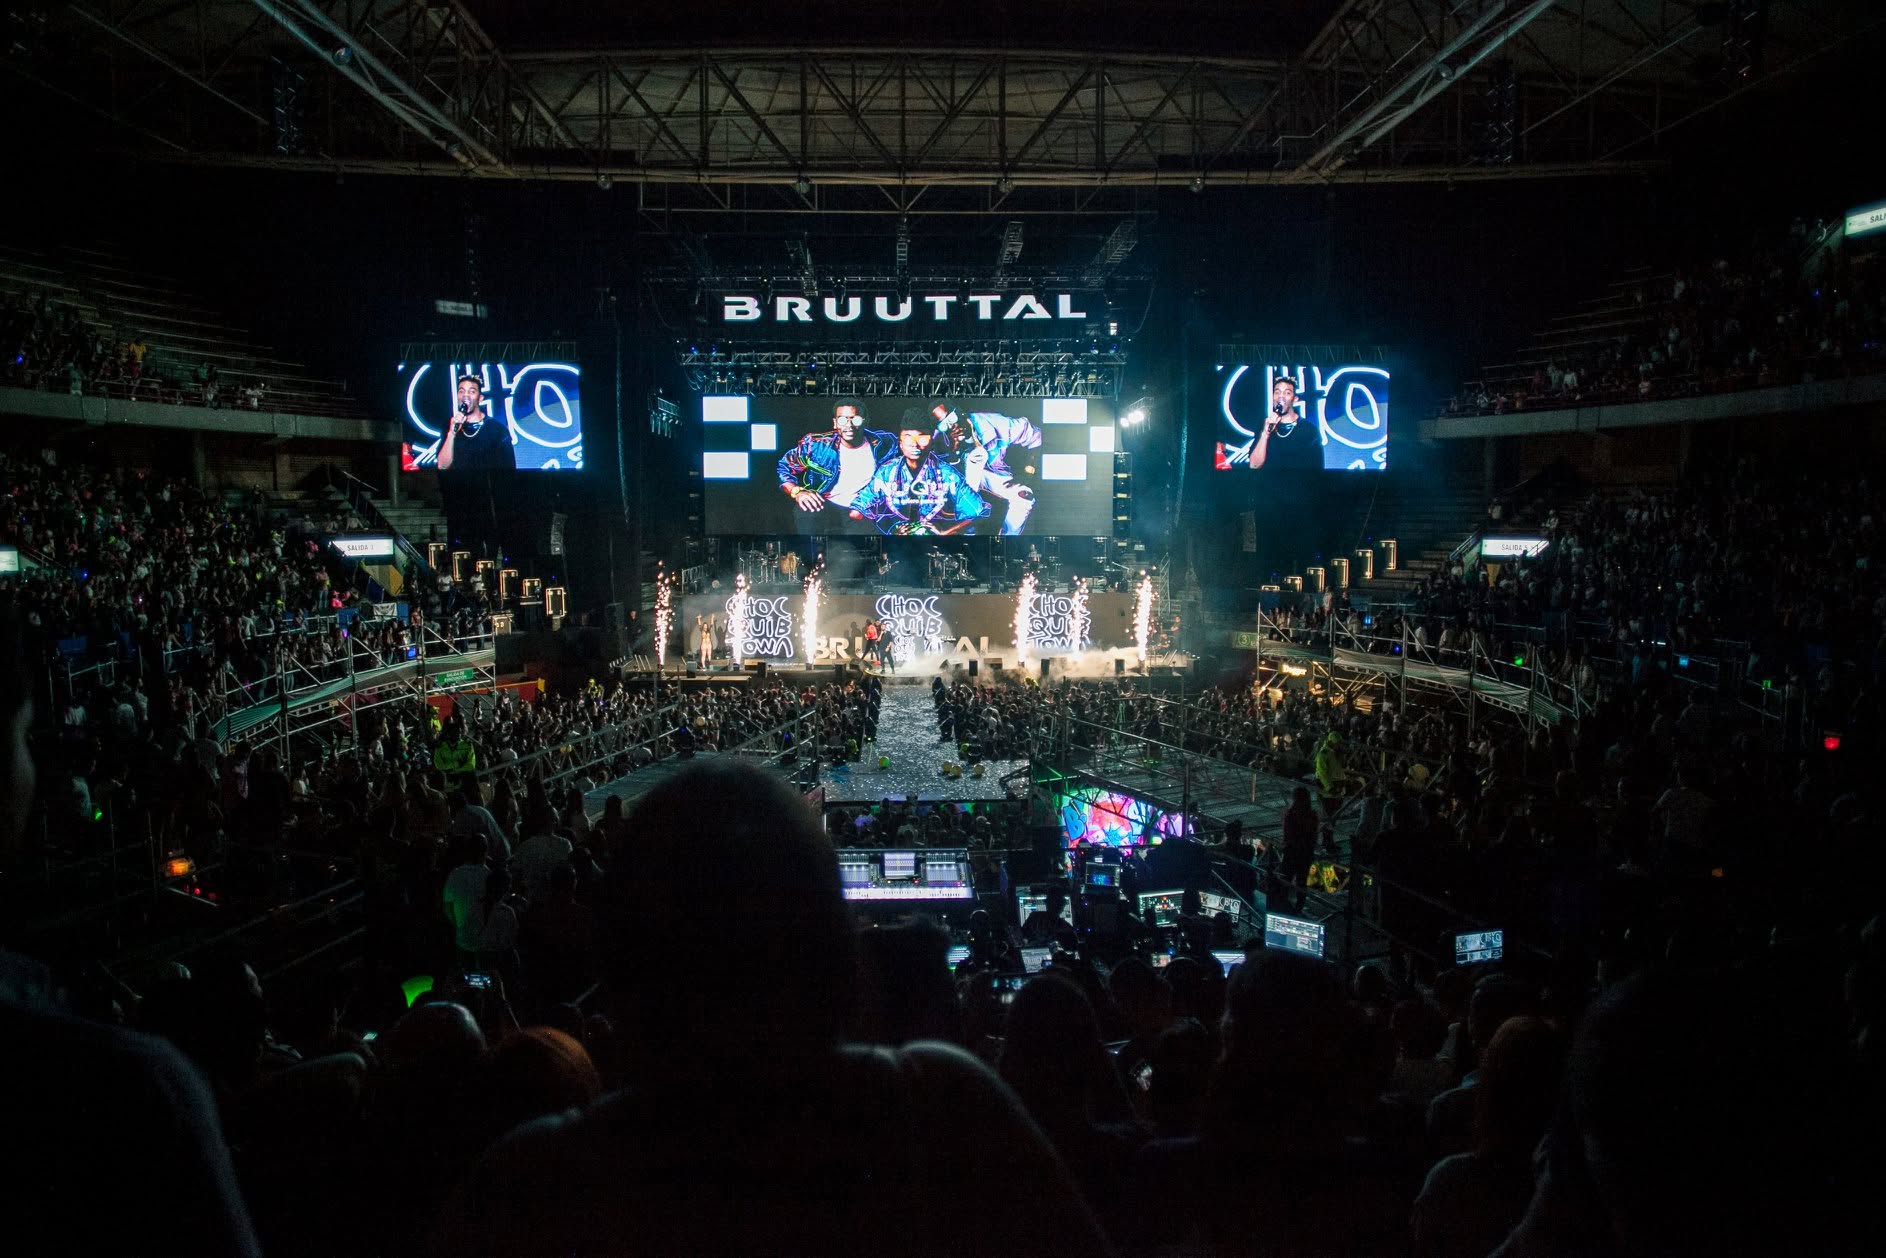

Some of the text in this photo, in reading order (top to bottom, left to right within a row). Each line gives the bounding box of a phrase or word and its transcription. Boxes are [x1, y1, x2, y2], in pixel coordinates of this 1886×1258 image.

[724, 294, 1087, 321] BRUUTTAL
[1502, 543, 1522, 551] SALIDA
[875, 594, 942, 618] CHOC
[725, 636, 794, 658] OWN
